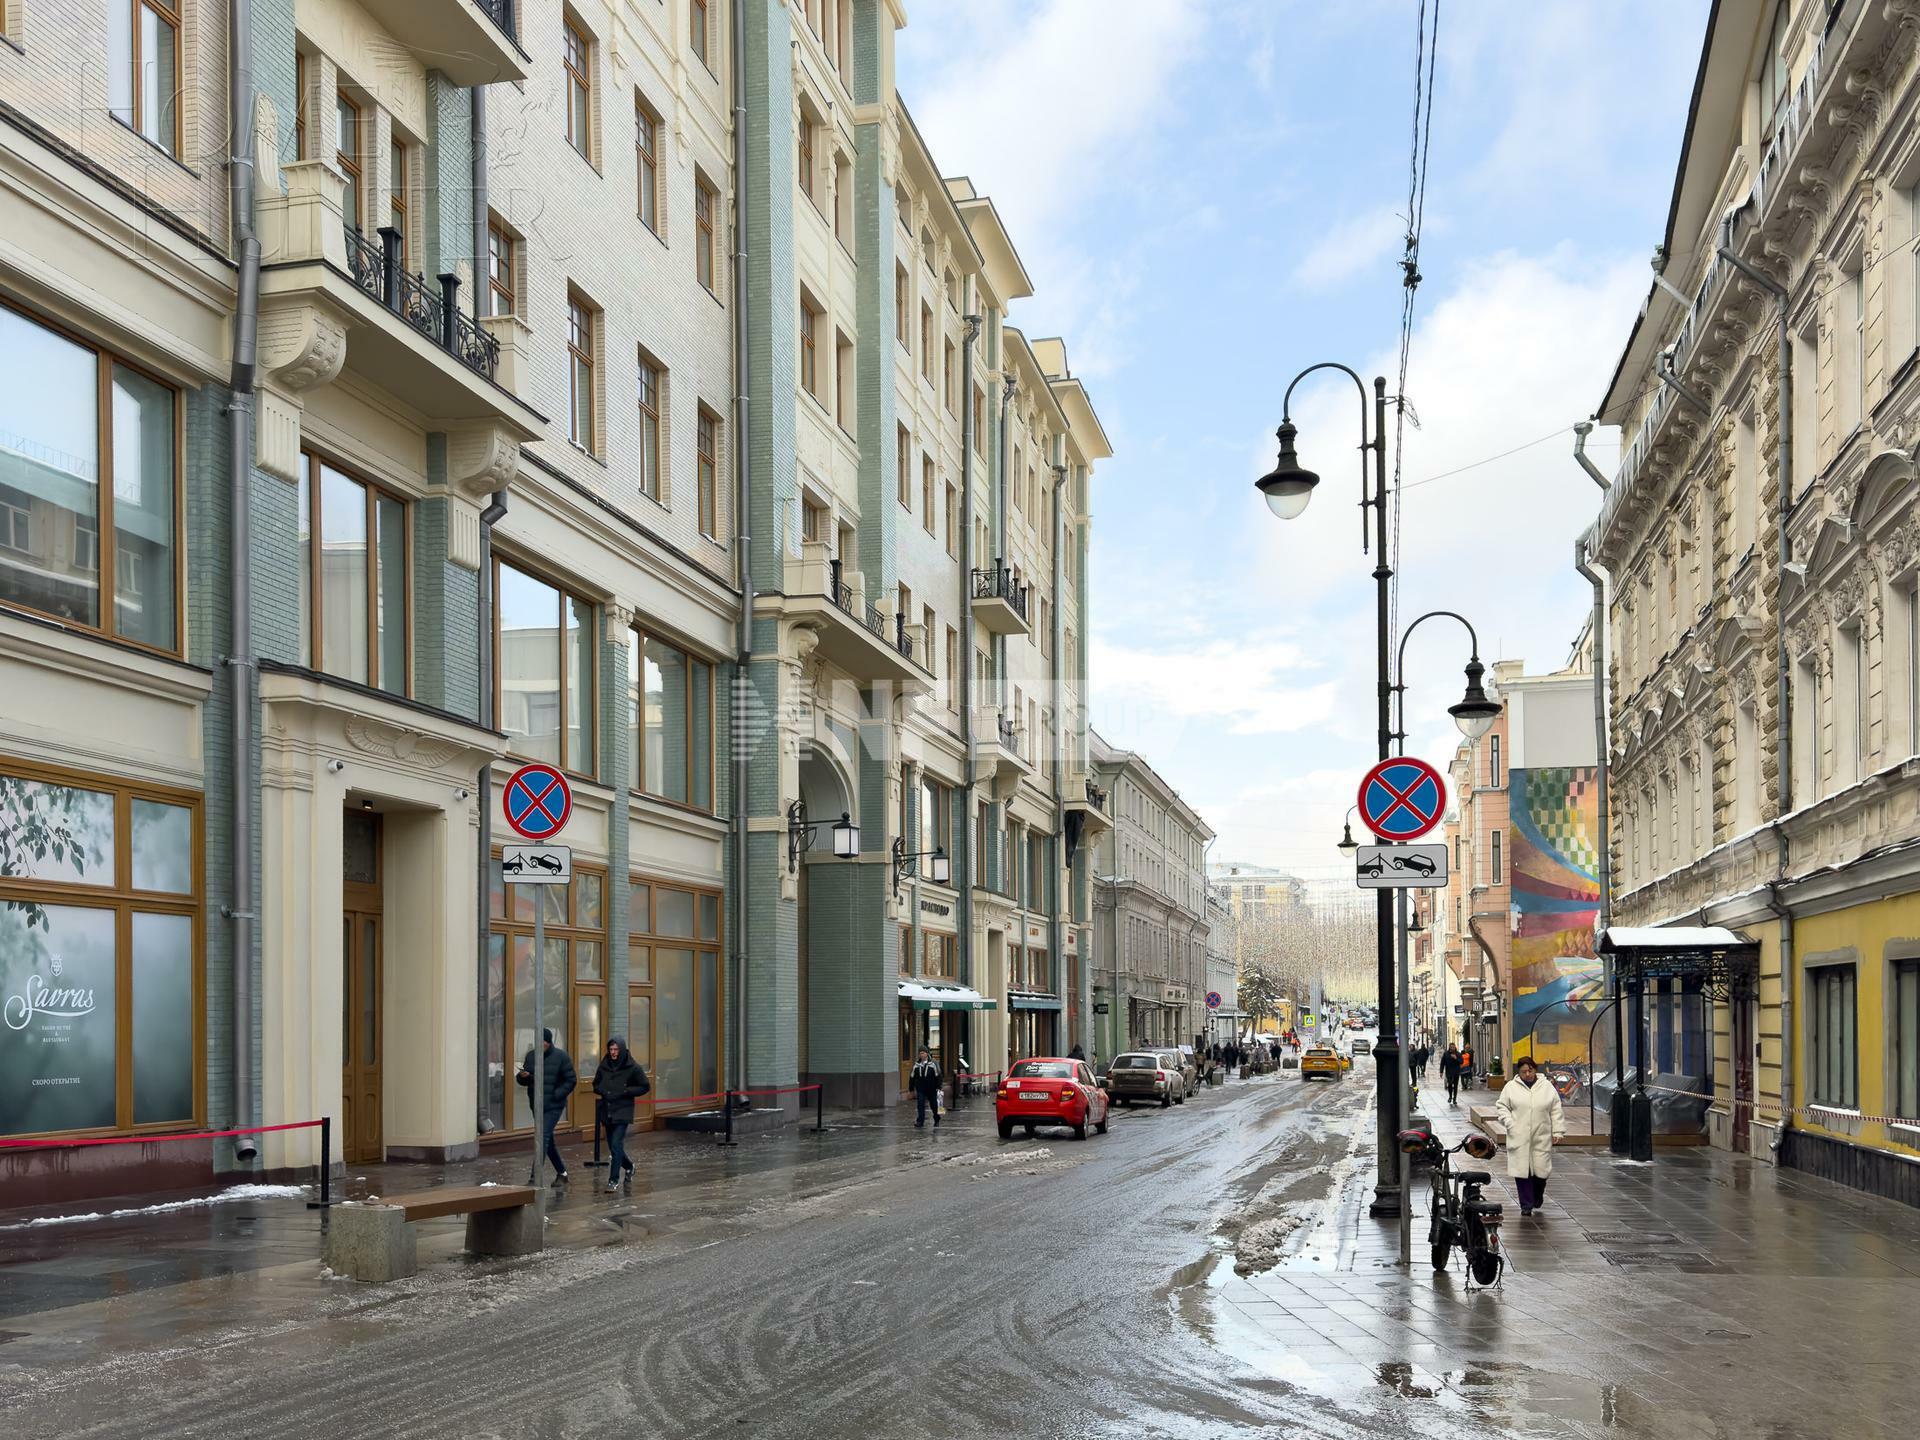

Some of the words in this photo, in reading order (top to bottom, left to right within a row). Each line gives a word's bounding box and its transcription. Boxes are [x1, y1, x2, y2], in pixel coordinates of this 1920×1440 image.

[4, 974, 96, 1030] Savras
[31, 1078, 51, 1086] СКОРО
[51, 1077, 81, 1085] ОТКРЫТИЕ
